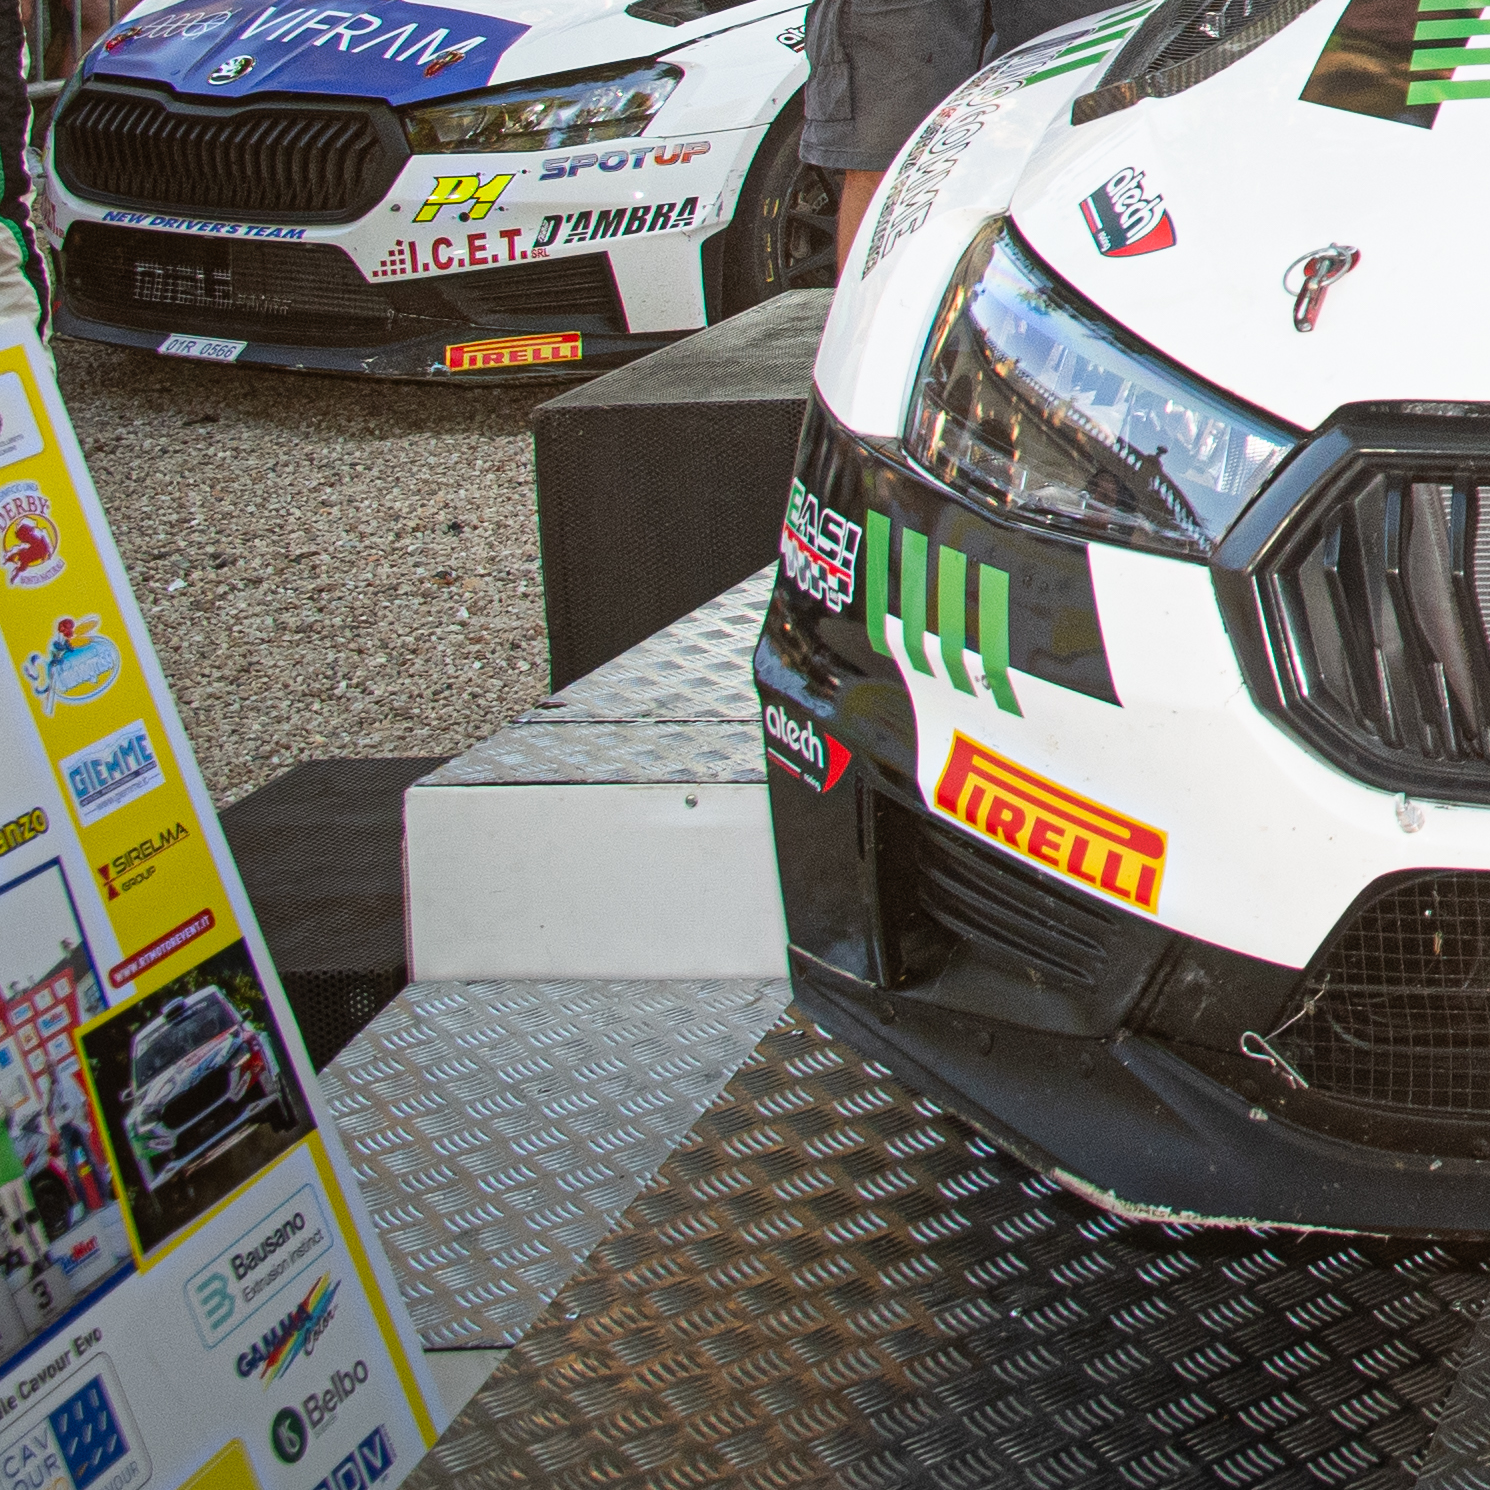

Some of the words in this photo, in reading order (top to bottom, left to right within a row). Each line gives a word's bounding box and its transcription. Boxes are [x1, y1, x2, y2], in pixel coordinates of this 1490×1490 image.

[540, 141, 711, 181] SPOTUP
[102, 211, 146, 224] NEW
[148, 215, 241, 234] DRIVER'S
[244, 224, 306, 240] TEAM
[534, 197, 699, 248] D'AMBRA
[1106, 166, 1164, 244] atech
[407, 229, 528, 274] I.C.E.T.
[531, 247, 550, 259] SRL
[200, 342, 237, 359] 0566
[450, 334, 579, 369] PIRELLI
[69, 733, 153, 797] GIEMME
[765, 704, 825, 769] atech
[112, 822, 189, 876] SIRELMA
[937, 735, 1166, 907] PIRELLI
[230, 1211, 306, 1280] Bausano
[242, 1258, 290, 1304] Extrusion
[283, 1229, 325, 1272] instinct
[18, 1344, 72, 1400] Cavour
[73, 1326, 103, 1358] Evo
[305, 1359, 369, 1431] Belbo
[3, 1427, 51, 1479] CAV
